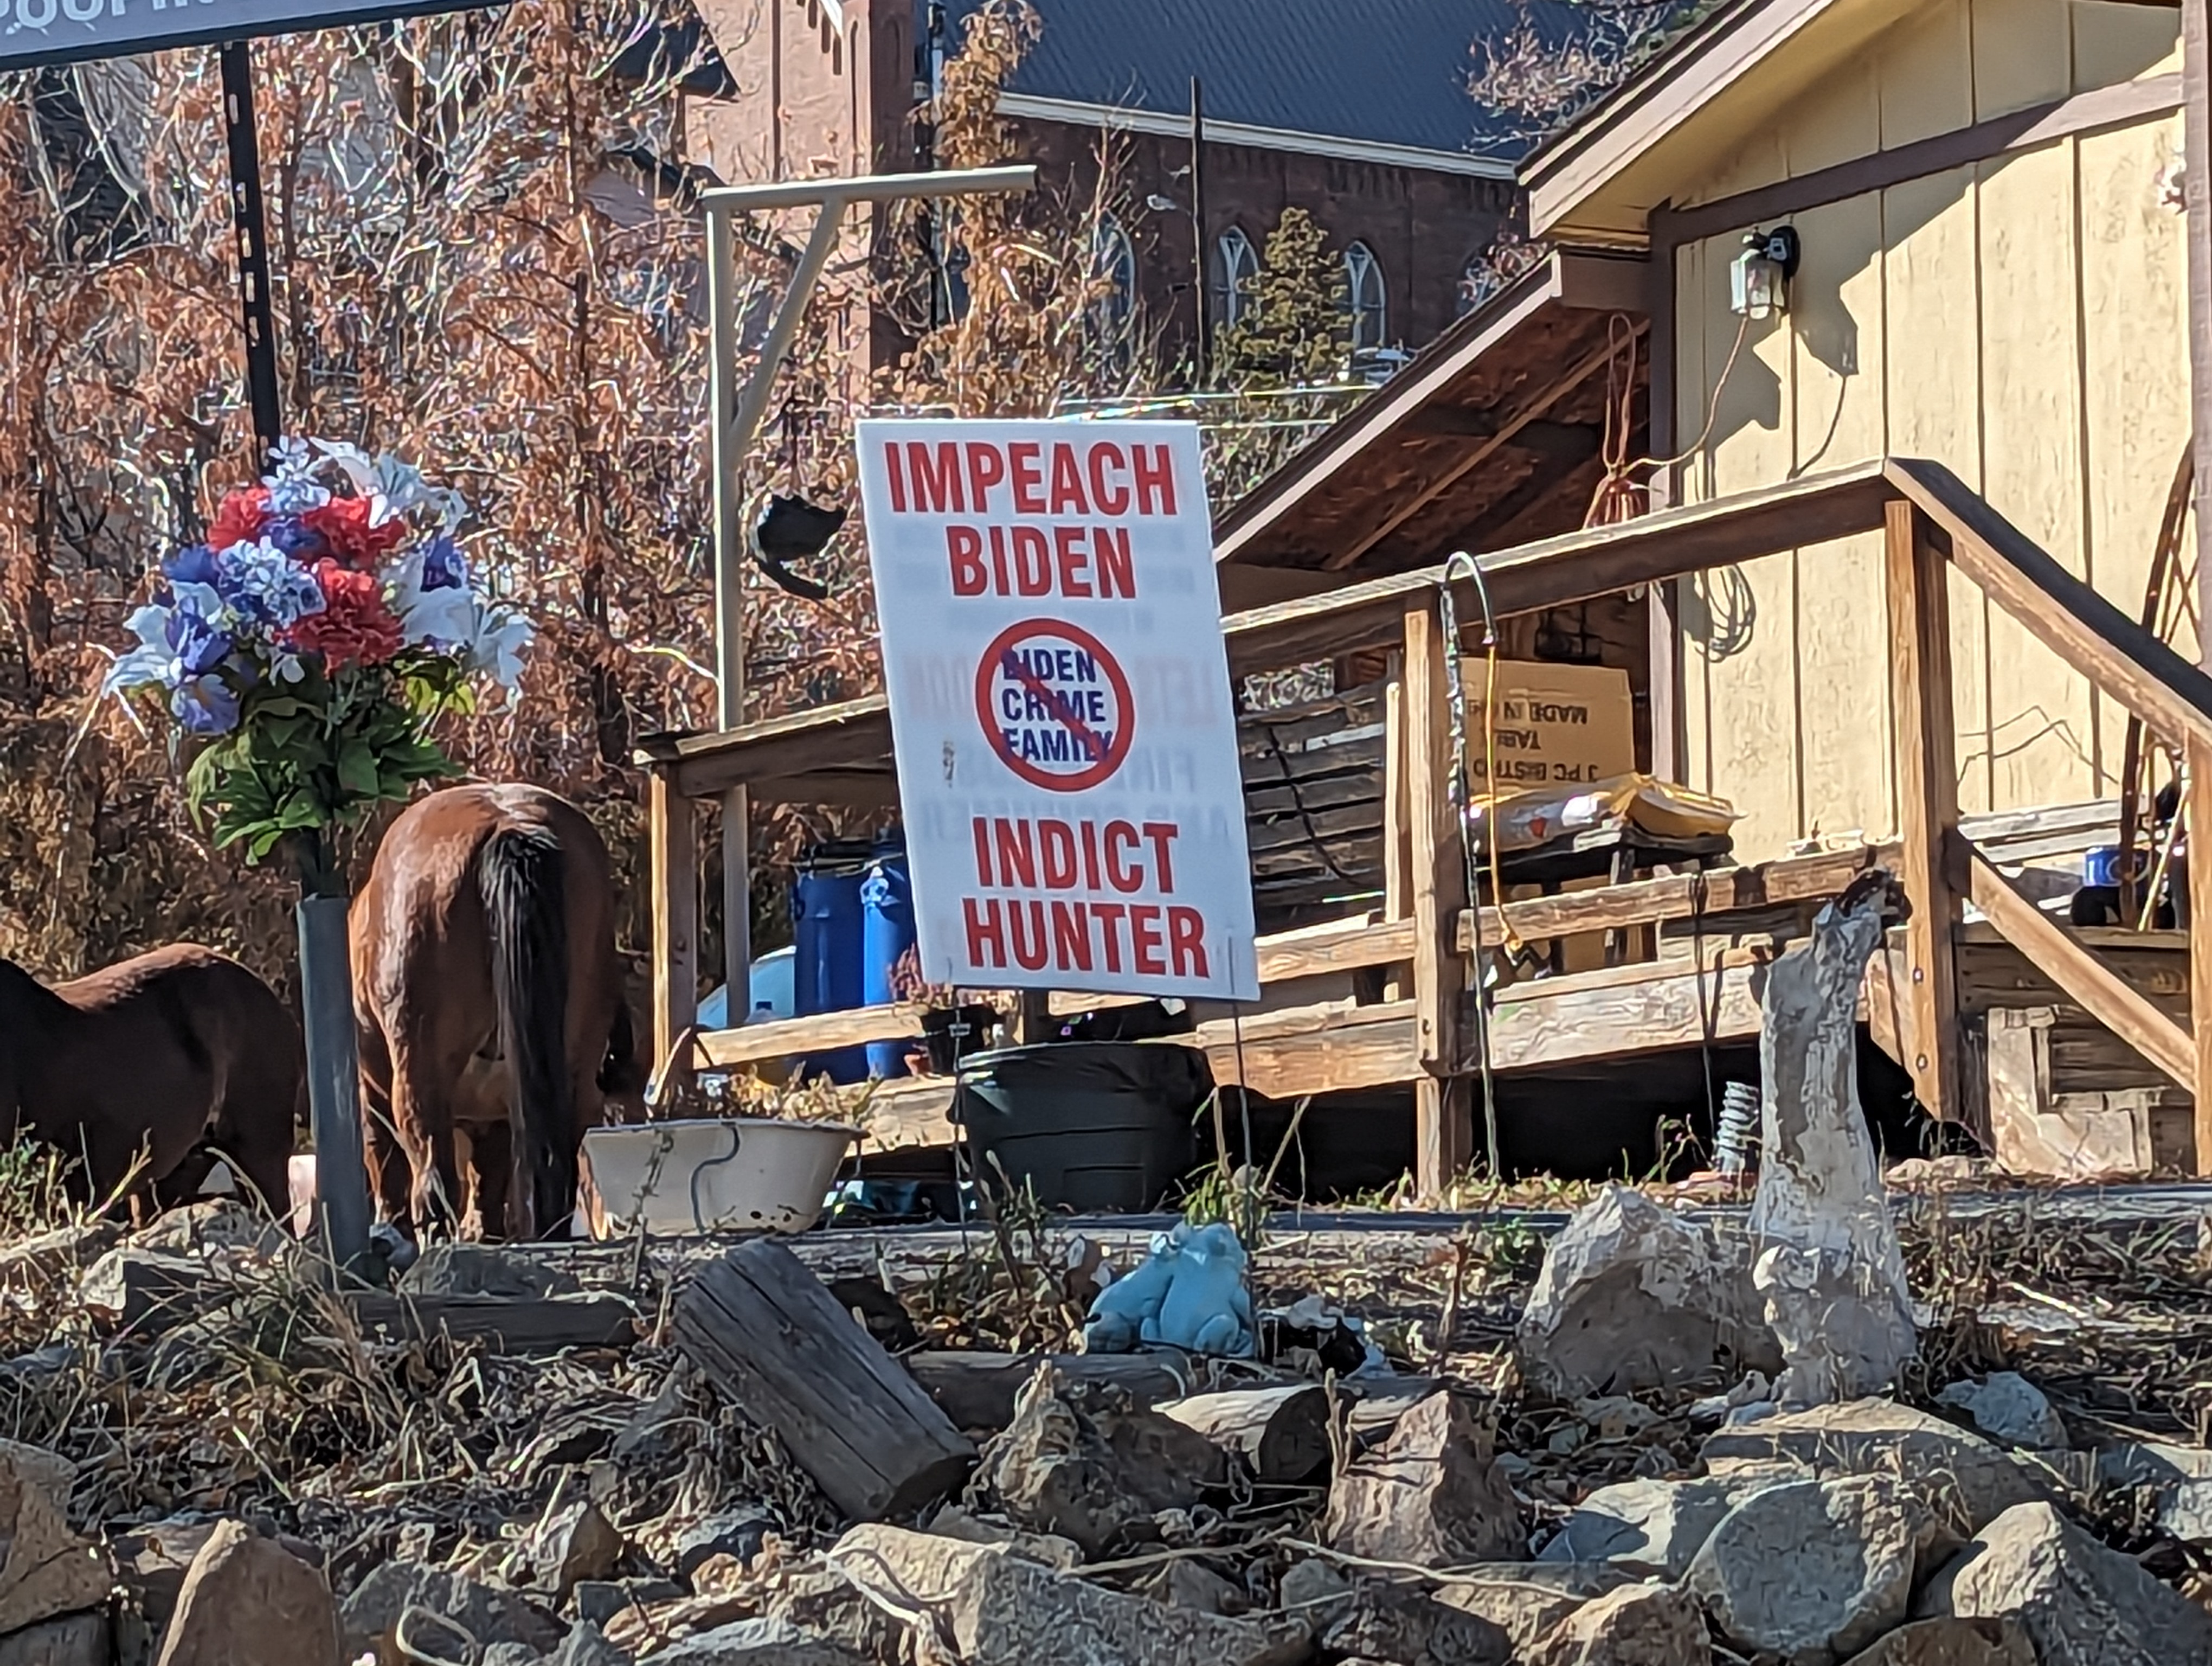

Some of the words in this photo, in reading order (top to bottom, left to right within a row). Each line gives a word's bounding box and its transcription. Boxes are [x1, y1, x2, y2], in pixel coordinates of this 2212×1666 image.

[885, 442, 1177, 515] IMPEACH
[946, 526, 1136, 598] BIDEN
[1001, 649, 1096, 682] BIDEN
[1529, 702, 1587, 725] MADE
[1002, 728, 1112, 761] FAMILY
[1554, 764, 1581, 782] PC
[973, 817, 1178, 893] INDICT
[963, 899, 1210, 978] HUNTER
